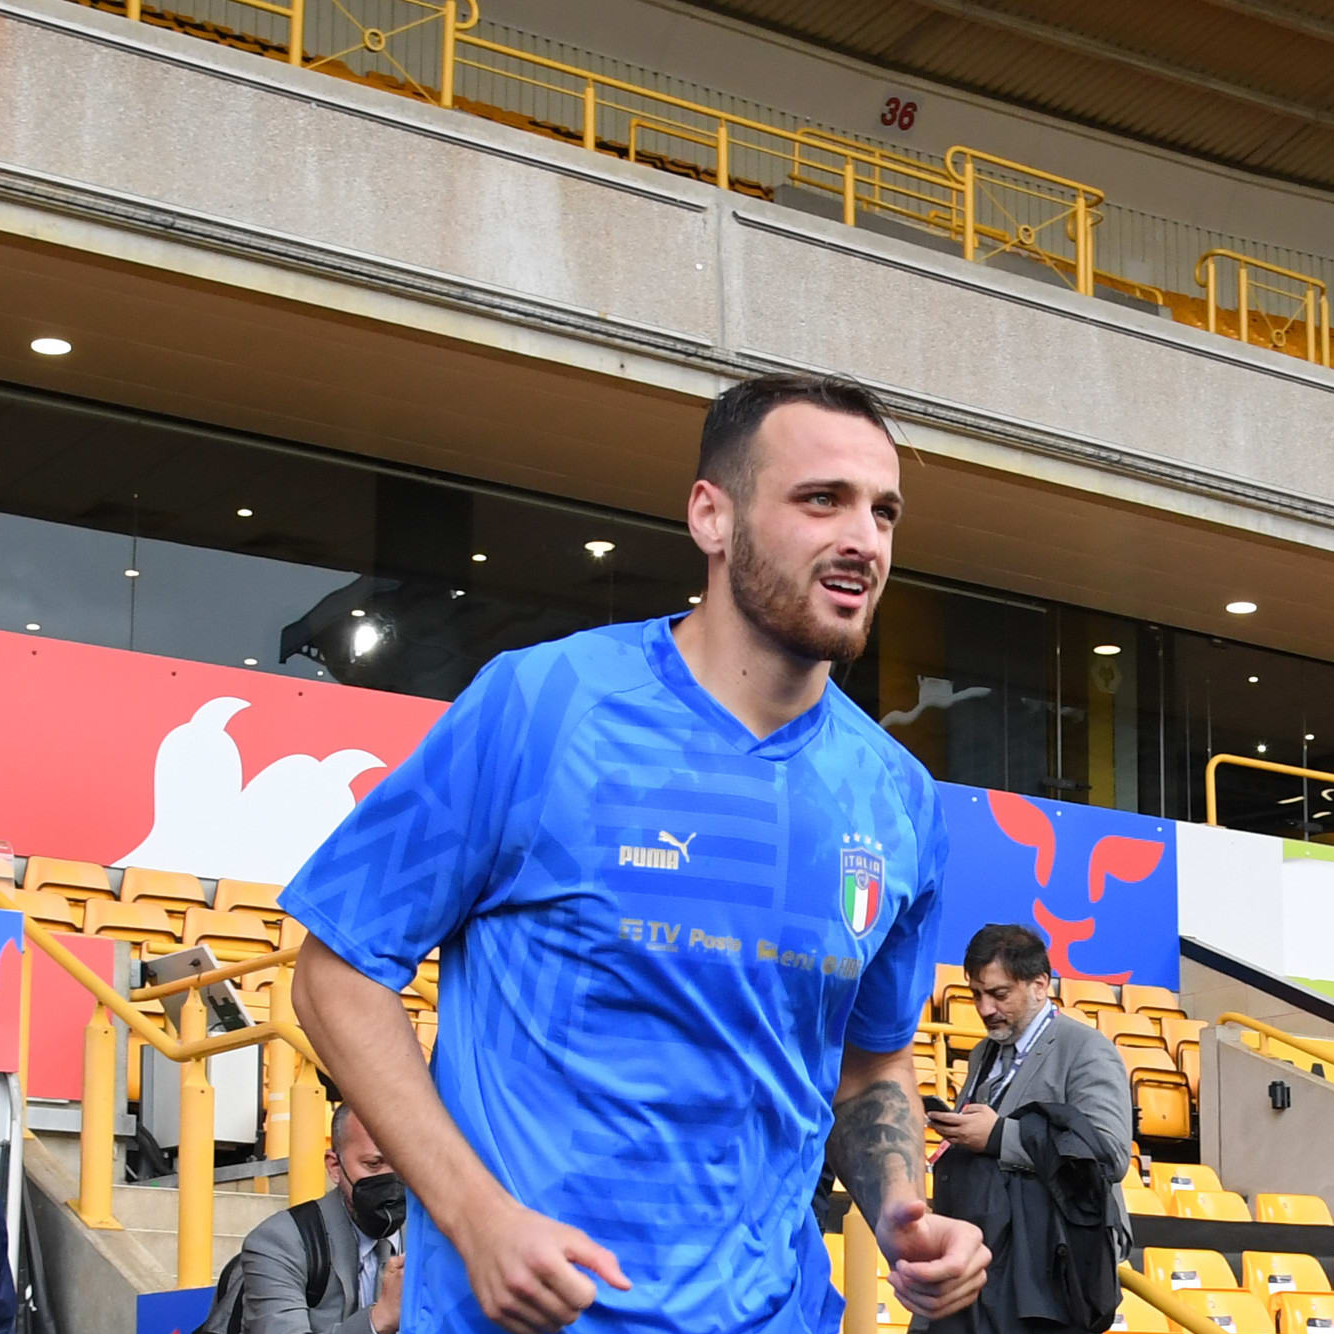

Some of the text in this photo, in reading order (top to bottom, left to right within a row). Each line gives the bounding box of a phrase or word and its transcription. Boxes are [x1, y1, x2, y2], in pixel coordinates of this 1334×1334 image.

[880, 97, 917, 131] 36
[619, 845, 679, 870] PUMA
[844, 855, 880, 874] ITALIA
[648, 921, 681, 944] TV
[689, 928, 741, 952] Poste
